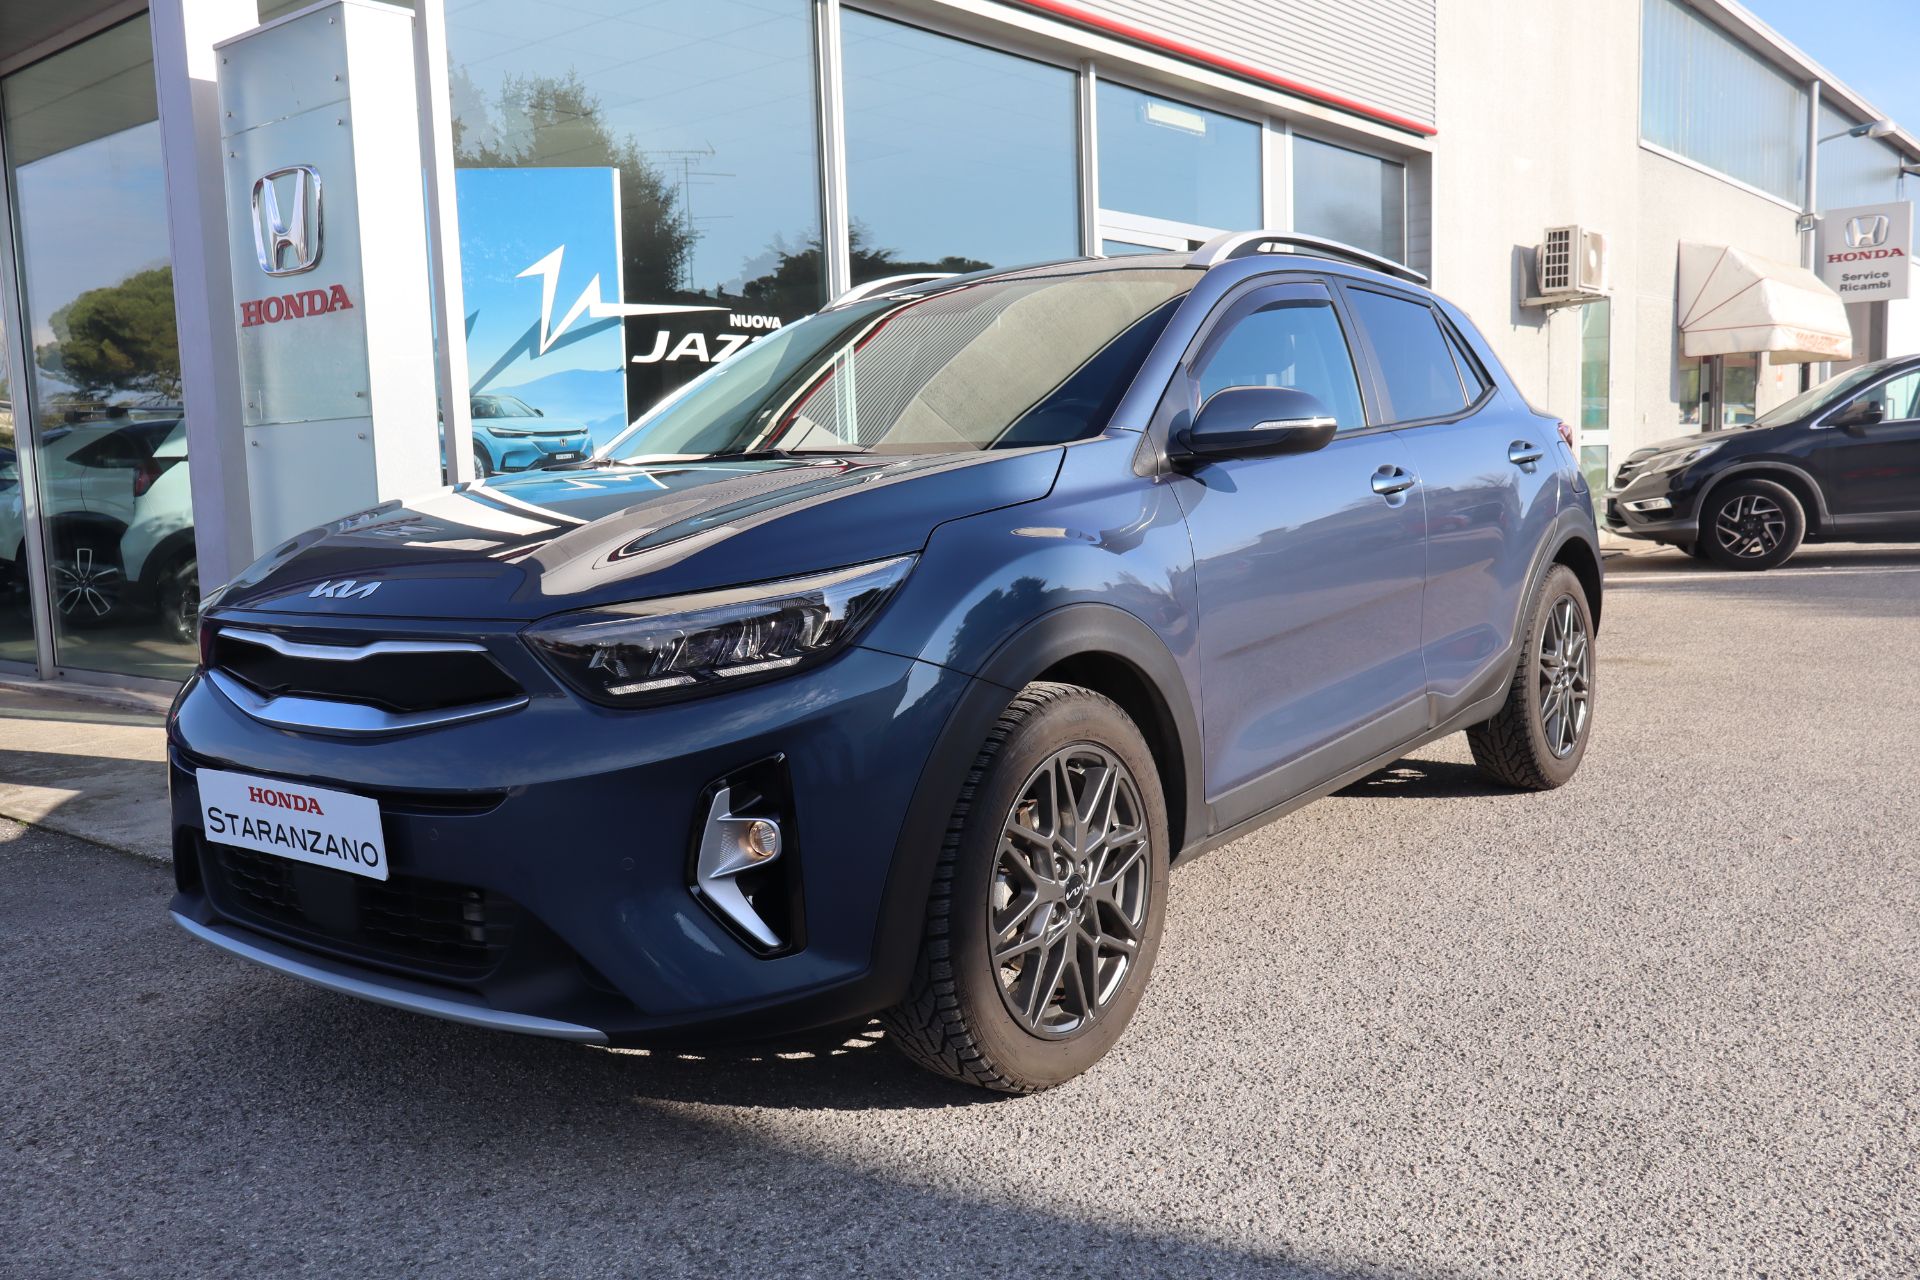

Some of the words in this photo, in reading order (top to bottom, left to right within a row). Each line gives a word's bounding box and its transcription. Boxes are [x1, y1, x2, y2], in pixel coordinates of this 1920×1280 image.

[1827, 248, 1904, 263] HONDA
[1839, 280, 1891, 292] Ricambi
[1842, 271, 1889, 281] Service
[240, 284, 353, 327] HONDA
[730, 314, 782, 329] NUOVA
[631, 330, 764, 363] JAZ
[248, 786, 324, 816] HONDA
[208, 807, 379, 867] STARANZANO
